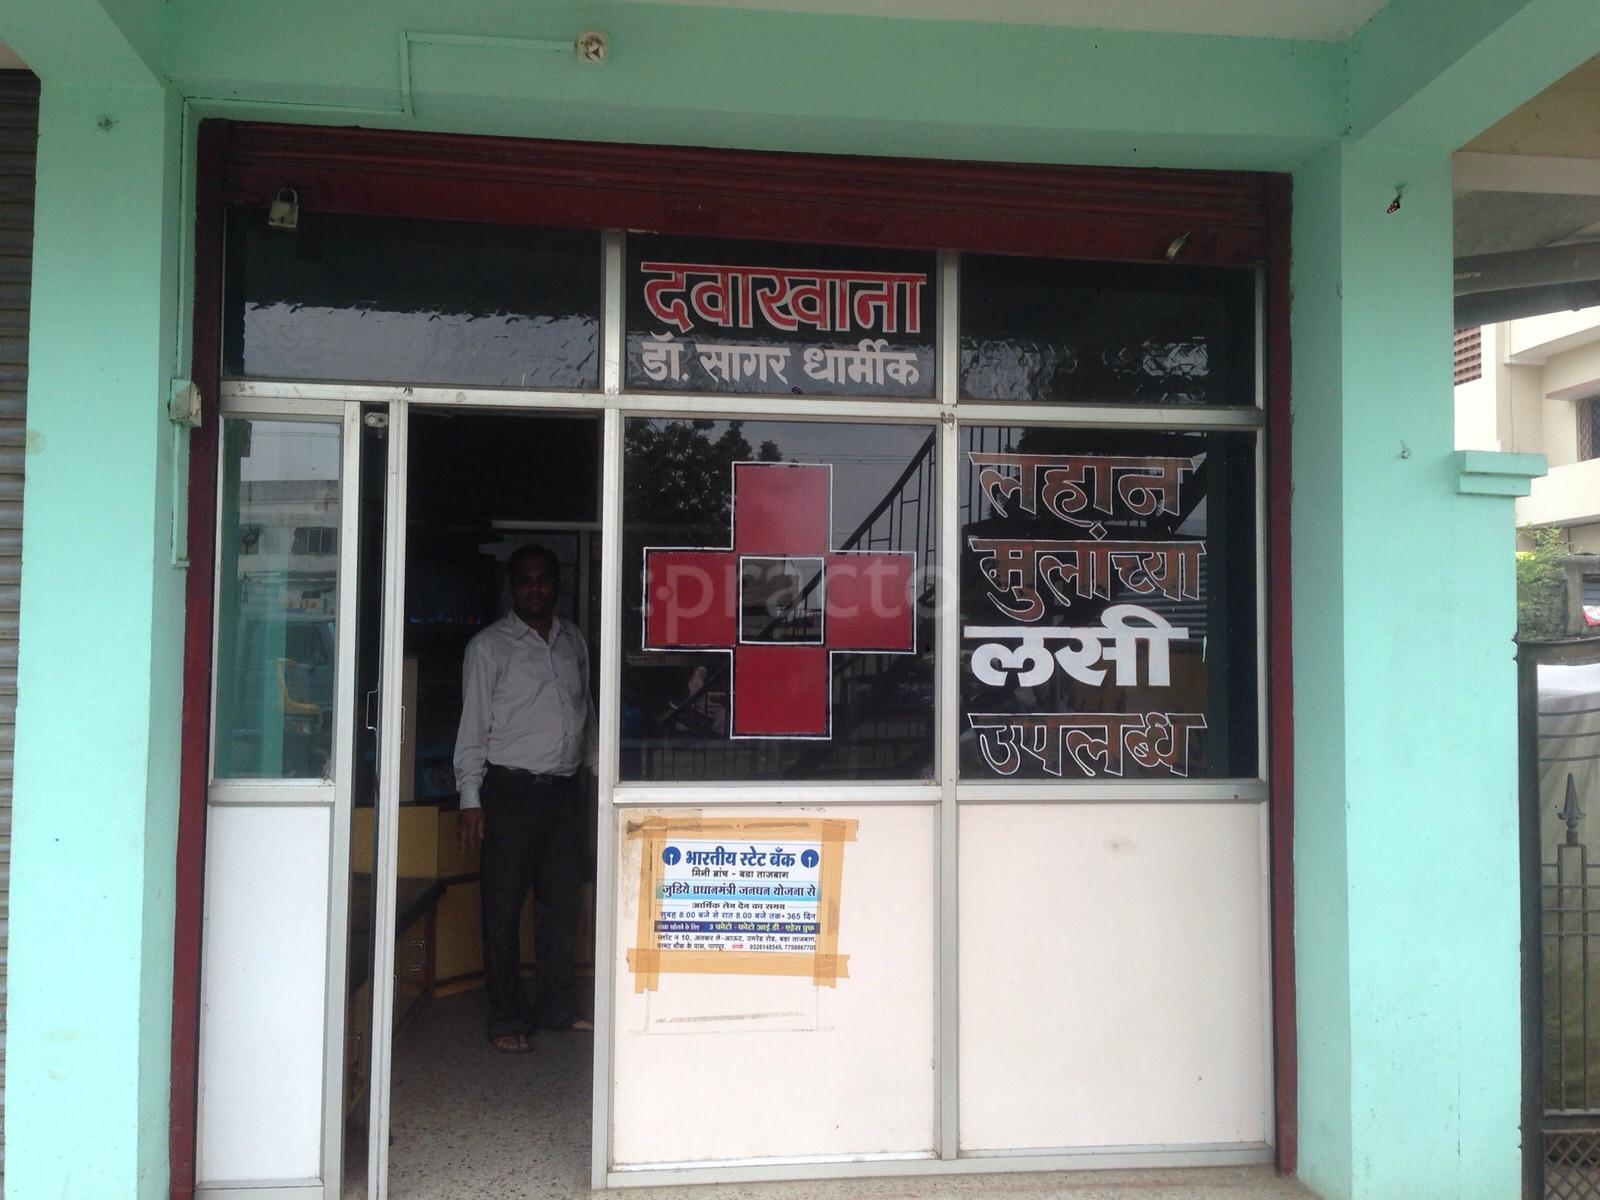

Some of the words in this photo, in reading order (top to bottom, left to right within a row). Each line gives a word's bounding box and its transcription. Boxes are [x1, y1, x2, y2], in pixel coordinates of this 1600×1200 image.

[641, 261, 928, 333] दवाखाना
[641, 330, 690, 382] डॉ.
[695, 343, 791, 385] सागर
[967, 451, 1196, 527] लहान
[964, 604, 1190, 687] लसी
[967, 712, 1208, 777] उपलब्ध
[686, 845, 738, 866] भारतीय
[740, 846, 767, 867] स्टेट
[692, 866, 710, 877] मिनी
[756, 871, 789, 879] ताजबाग
[662, 882, 690, 898] जुडिये
[693, 882, 736, 895] प्रधानमंत्री
[739, 886, 770, 896] जनधन
[773, 884, 804, 896] योजना
[807, 884, 816, 896] से
[692, 901, 720, 909] आर्थिक
[722, 901, 735, 909] लेन
[738, 901, 749, 910] देन
[698, 910, 709, 919] बजे
[712, 910, 719, 919] से
[755, 911, 766, 919] बजे
[787, 912, 801, 920] 365
[803, 911, 816, 921] दिन
